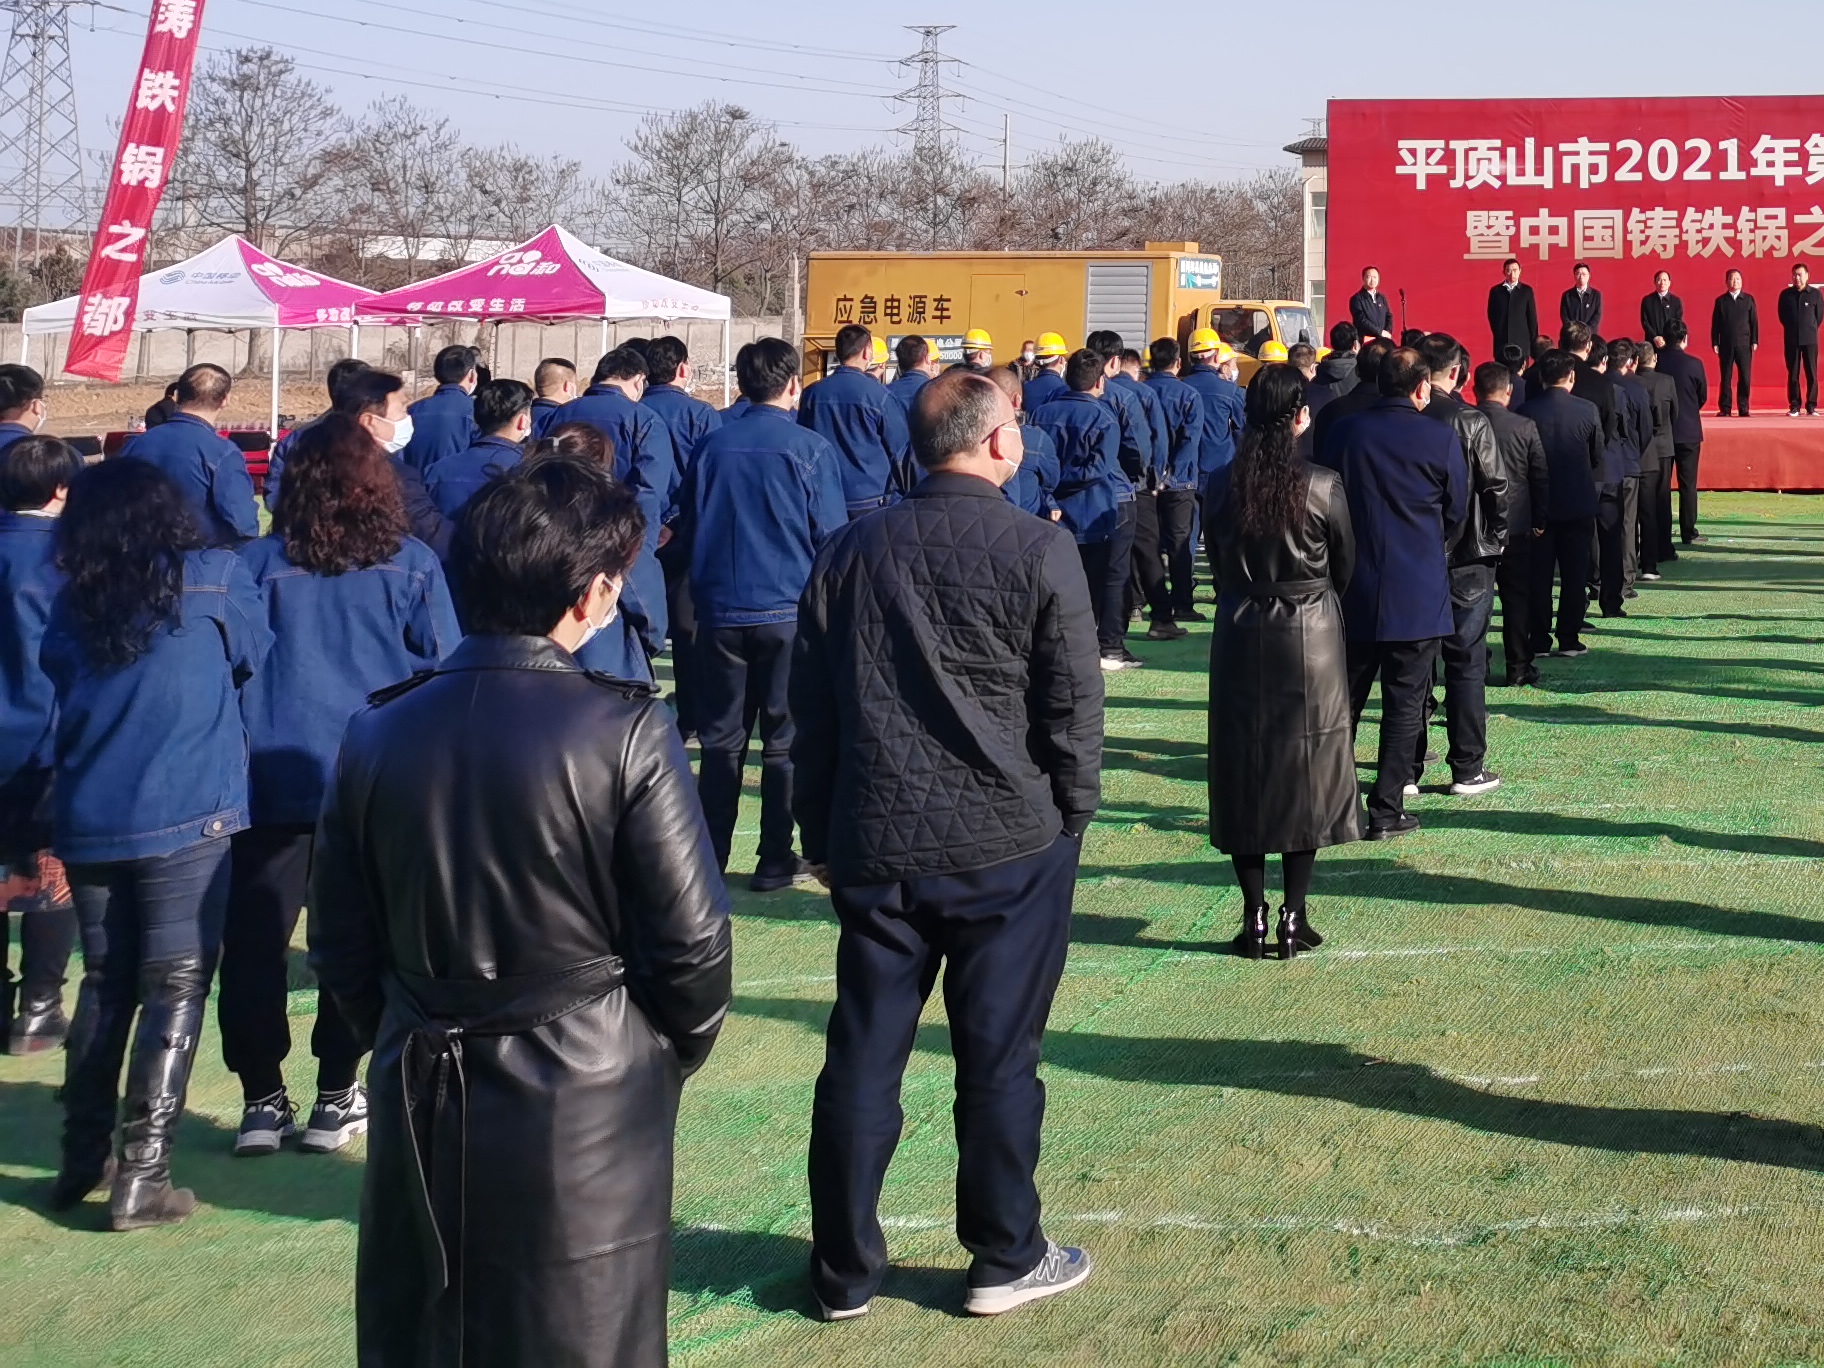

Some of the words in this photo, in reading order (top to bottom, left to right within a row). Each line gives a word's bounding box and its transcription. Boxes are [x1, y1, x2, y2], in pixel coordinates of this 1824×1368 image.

[834, 294, 952, 325] 应急电源车
